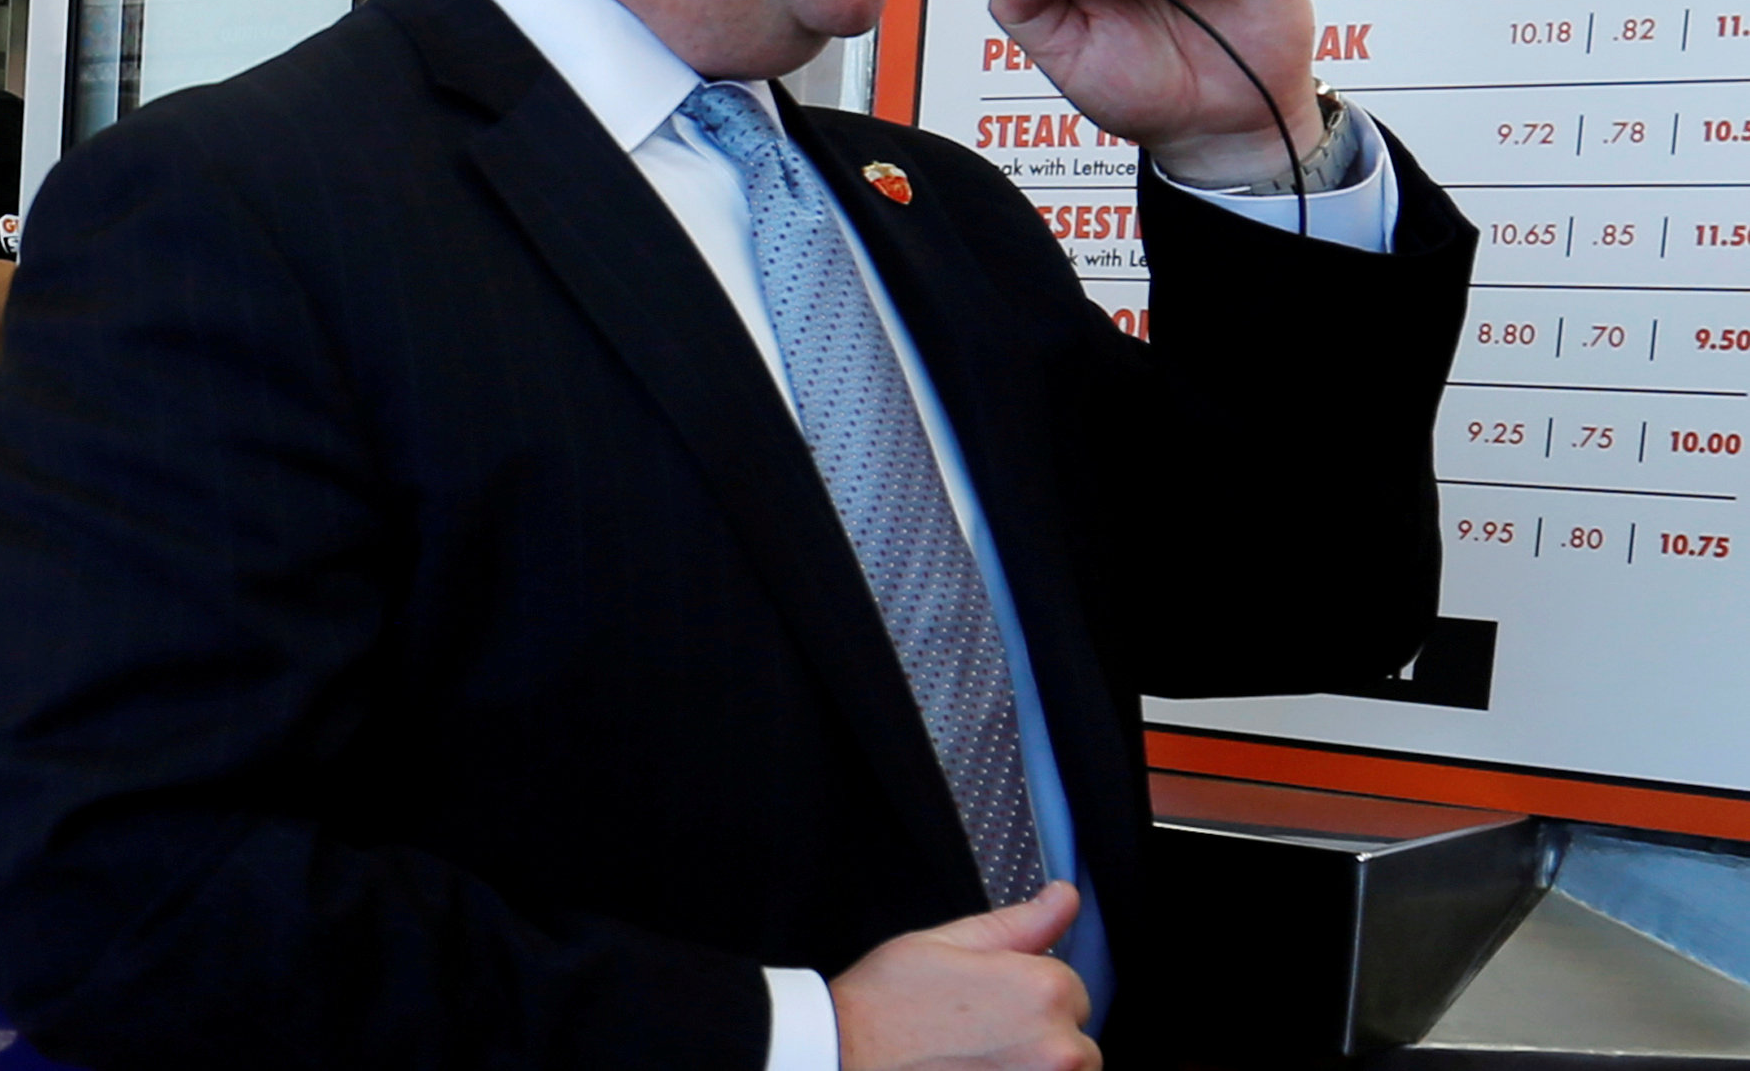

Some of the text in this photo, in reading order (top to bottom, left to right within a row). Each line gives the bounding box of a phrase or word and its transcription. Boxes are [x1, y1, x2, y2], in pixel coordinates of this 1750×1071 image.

[1510, 22, 1571, 44] 10.18
[1613, 18, 1655, 41] .82
[976, 114, 1082, 148] STEAK
[1497, 123, 1555, 145] 9.72
[1603, 122, 1645, 144] .78
[1029, 158, 1065, 176] with
[1073, 159, 1136, 176] Lettuce
[1491, 224, 1750, 247] 10.65 .85 11.5
[1084, 249, 1122, 267] with
[1477, 323, 1750, 351] 8.80 .70 9.50
[1467, 422, 1741, 455] 9.25 .75 10.00
[1457, 520, 1730, 558] 9.95 .80 10.75
